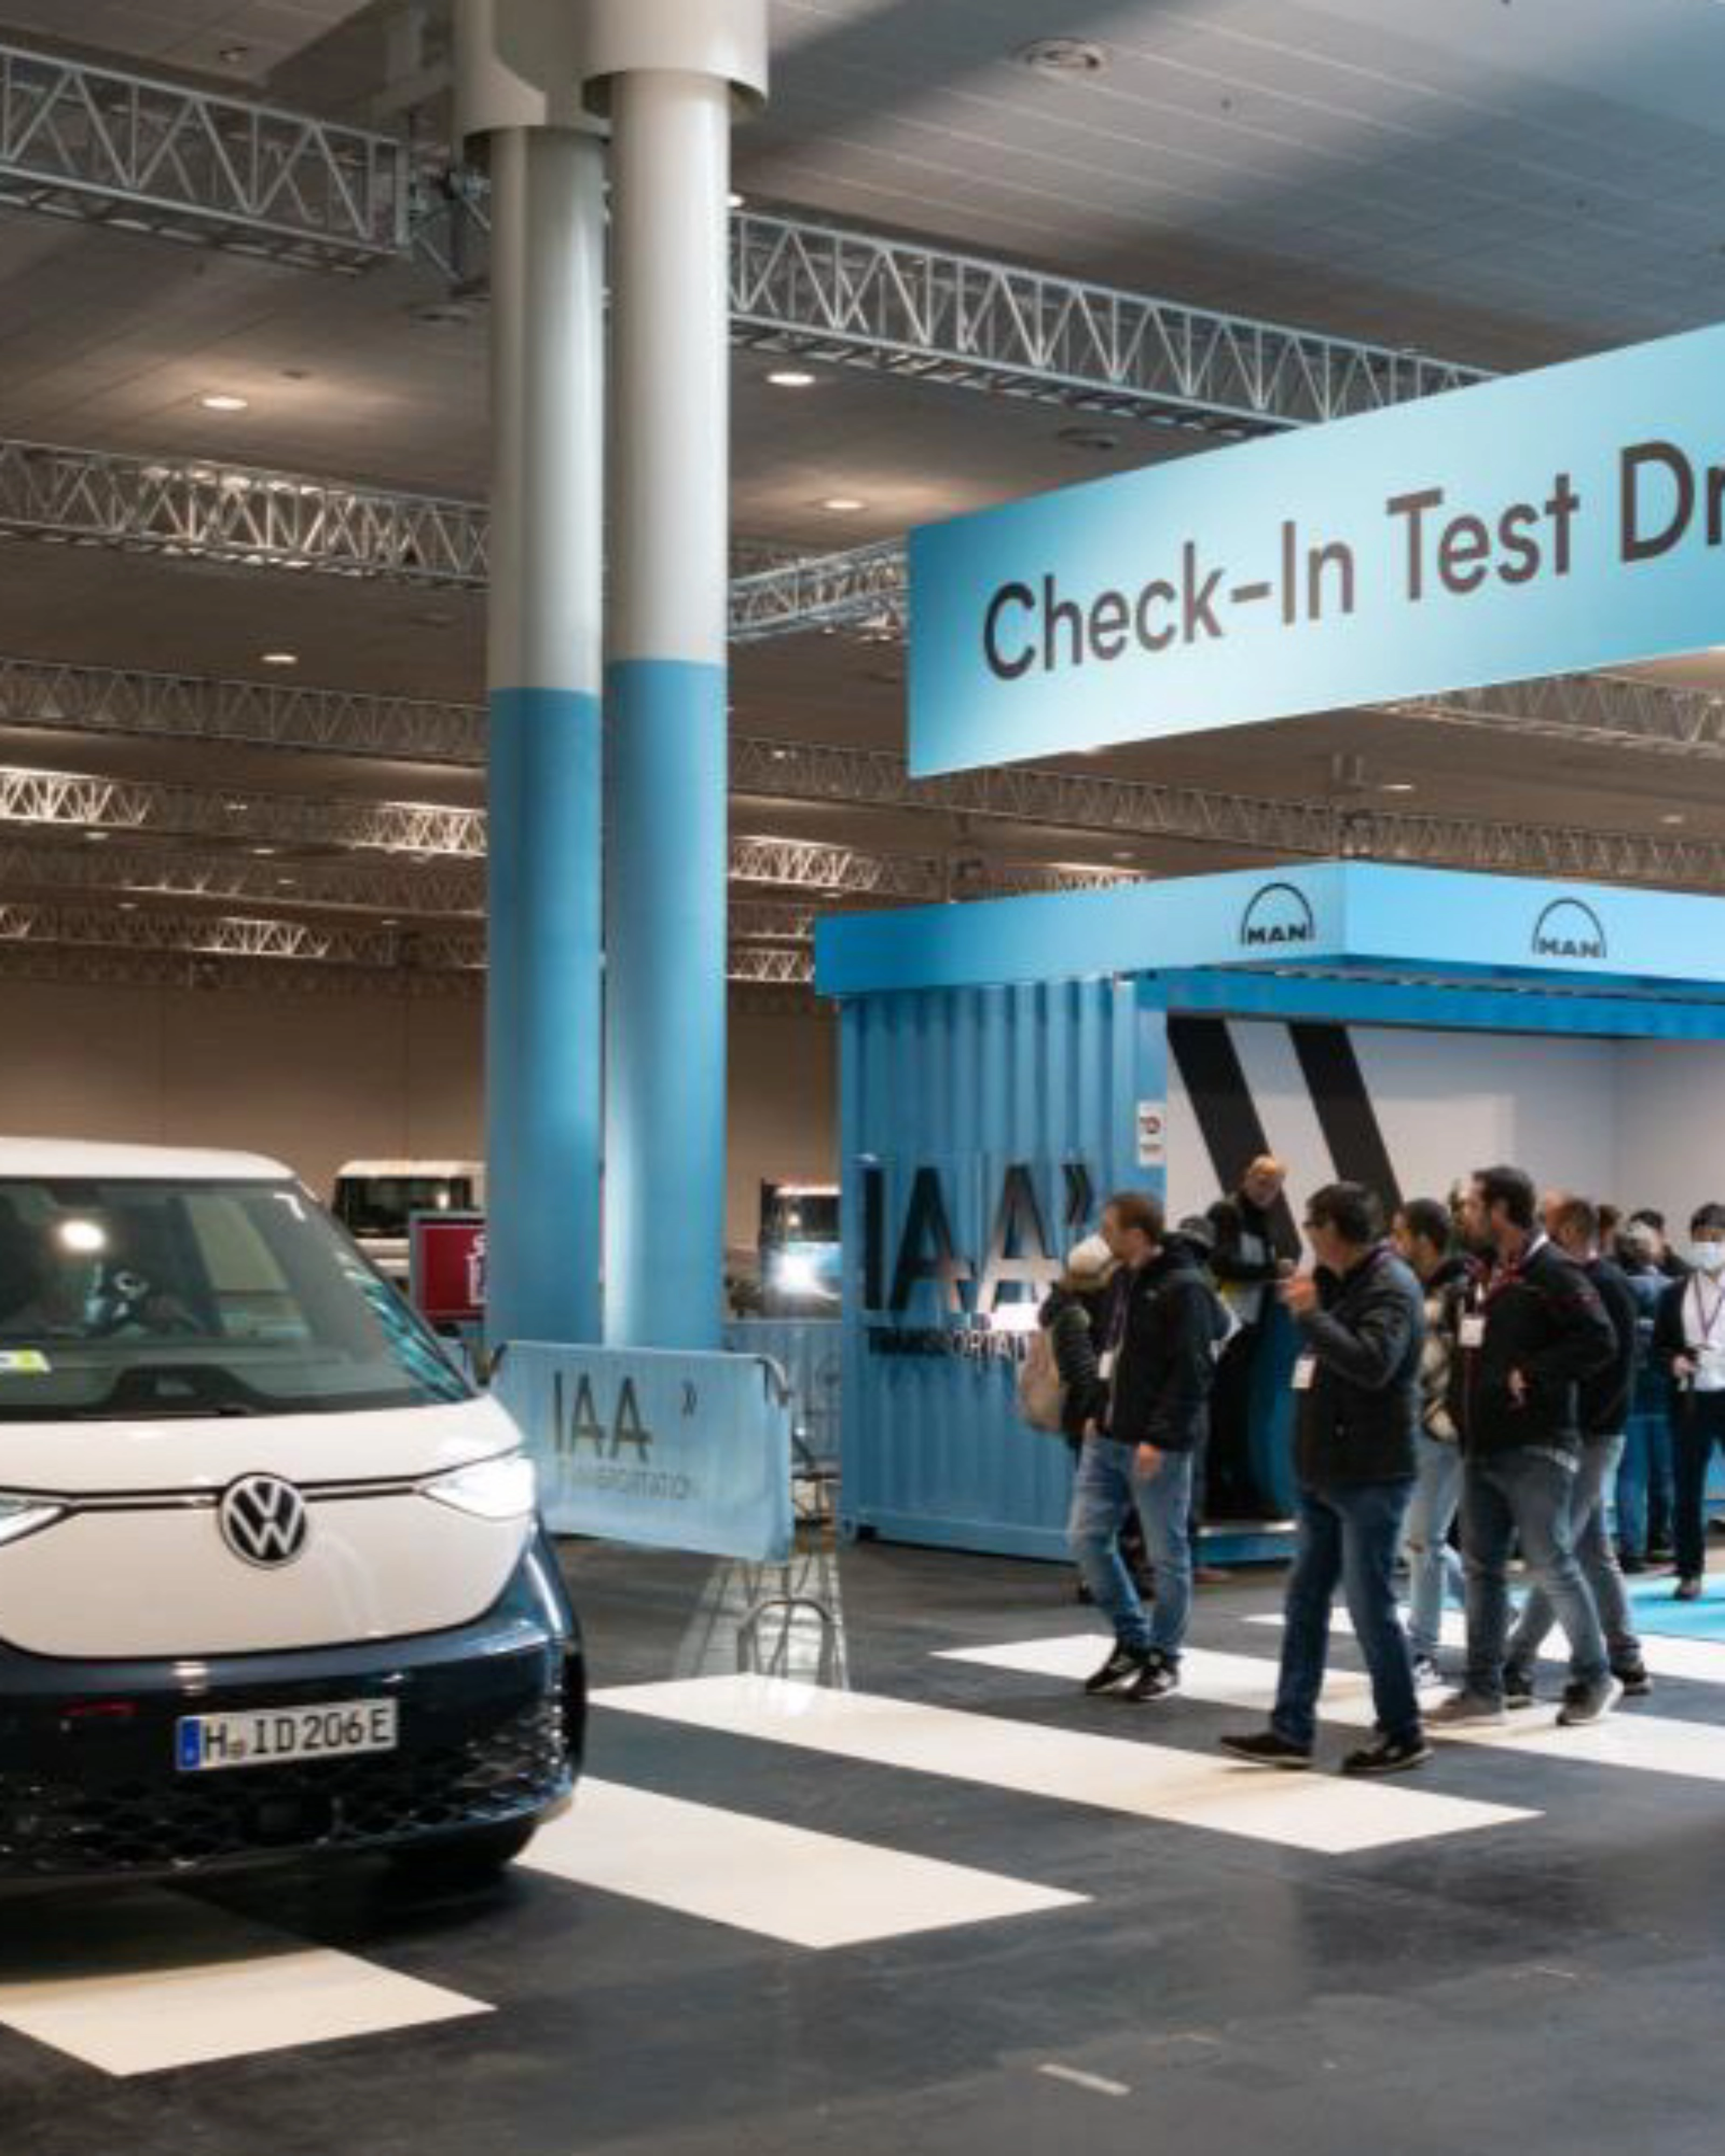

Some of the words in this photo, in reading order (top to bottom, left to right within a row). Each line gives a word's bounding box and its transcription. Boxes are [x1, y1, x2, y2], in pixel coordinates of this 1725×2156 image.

[983, 520, 1355, 681] Check-In
[1386, 474, 1580, 602] Test
[1247, 922, 1307, 944] MAN
[1538, 937, 1600, 958] MAN
[865, 1163, 1062, 1315] IAA
[554, 1371, 653, 1462] IAA
